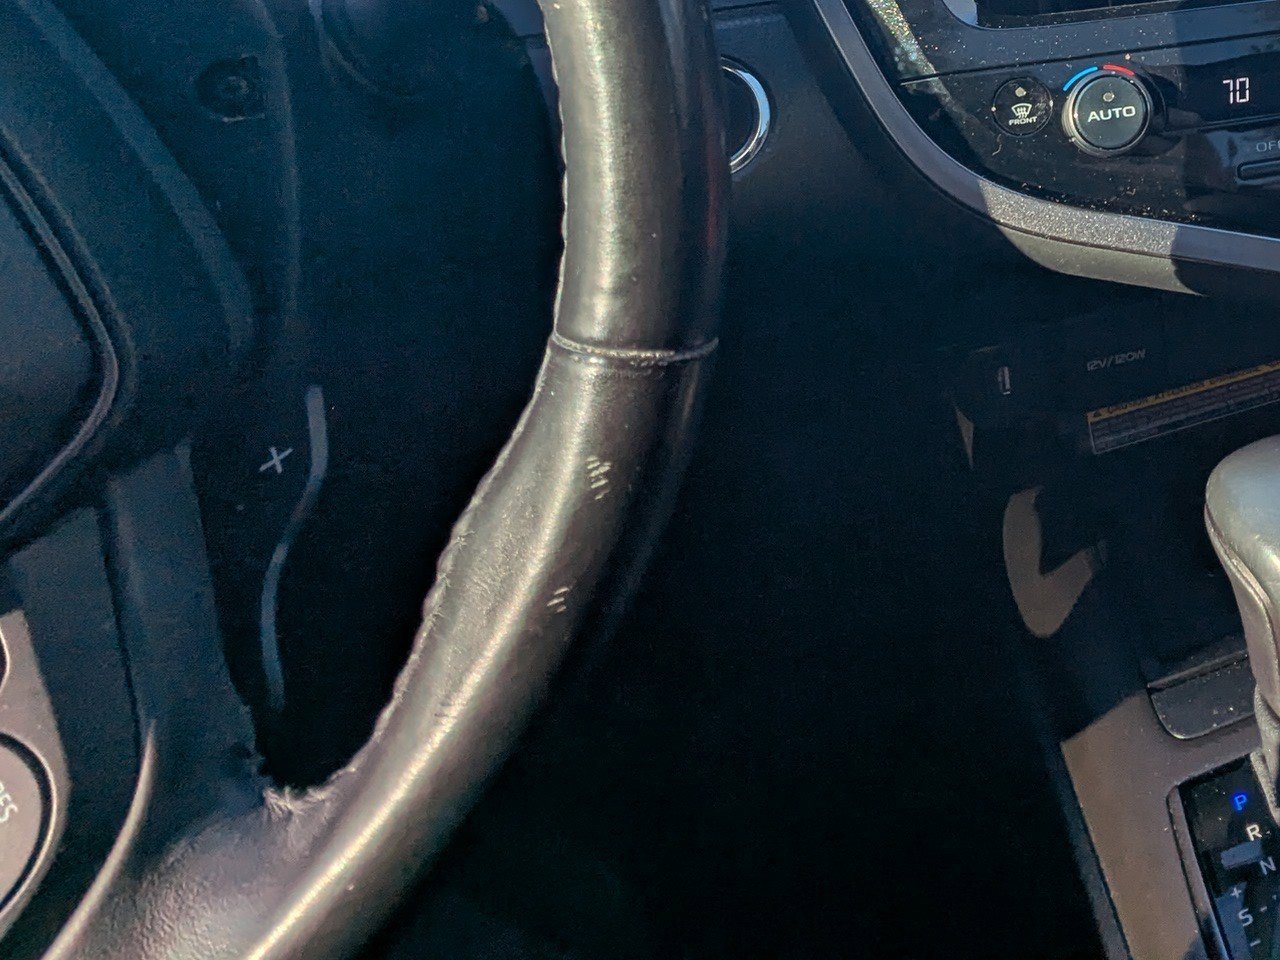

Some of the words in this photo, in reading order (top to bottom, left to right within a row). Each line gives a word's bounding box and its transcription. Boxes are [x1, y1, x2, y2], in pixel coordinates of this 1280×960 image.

[1222, 77, 1249, 104] 70
[1009, 115, 1038, 126] FRONT
[1087, 105, 1137, 123] AUTO
[1234, 794, 1247, 811] P
[1246, 824, 1263, 841] R
[1259, 857, 1277, 875] N
[1238, 908, 1253, 927] S
